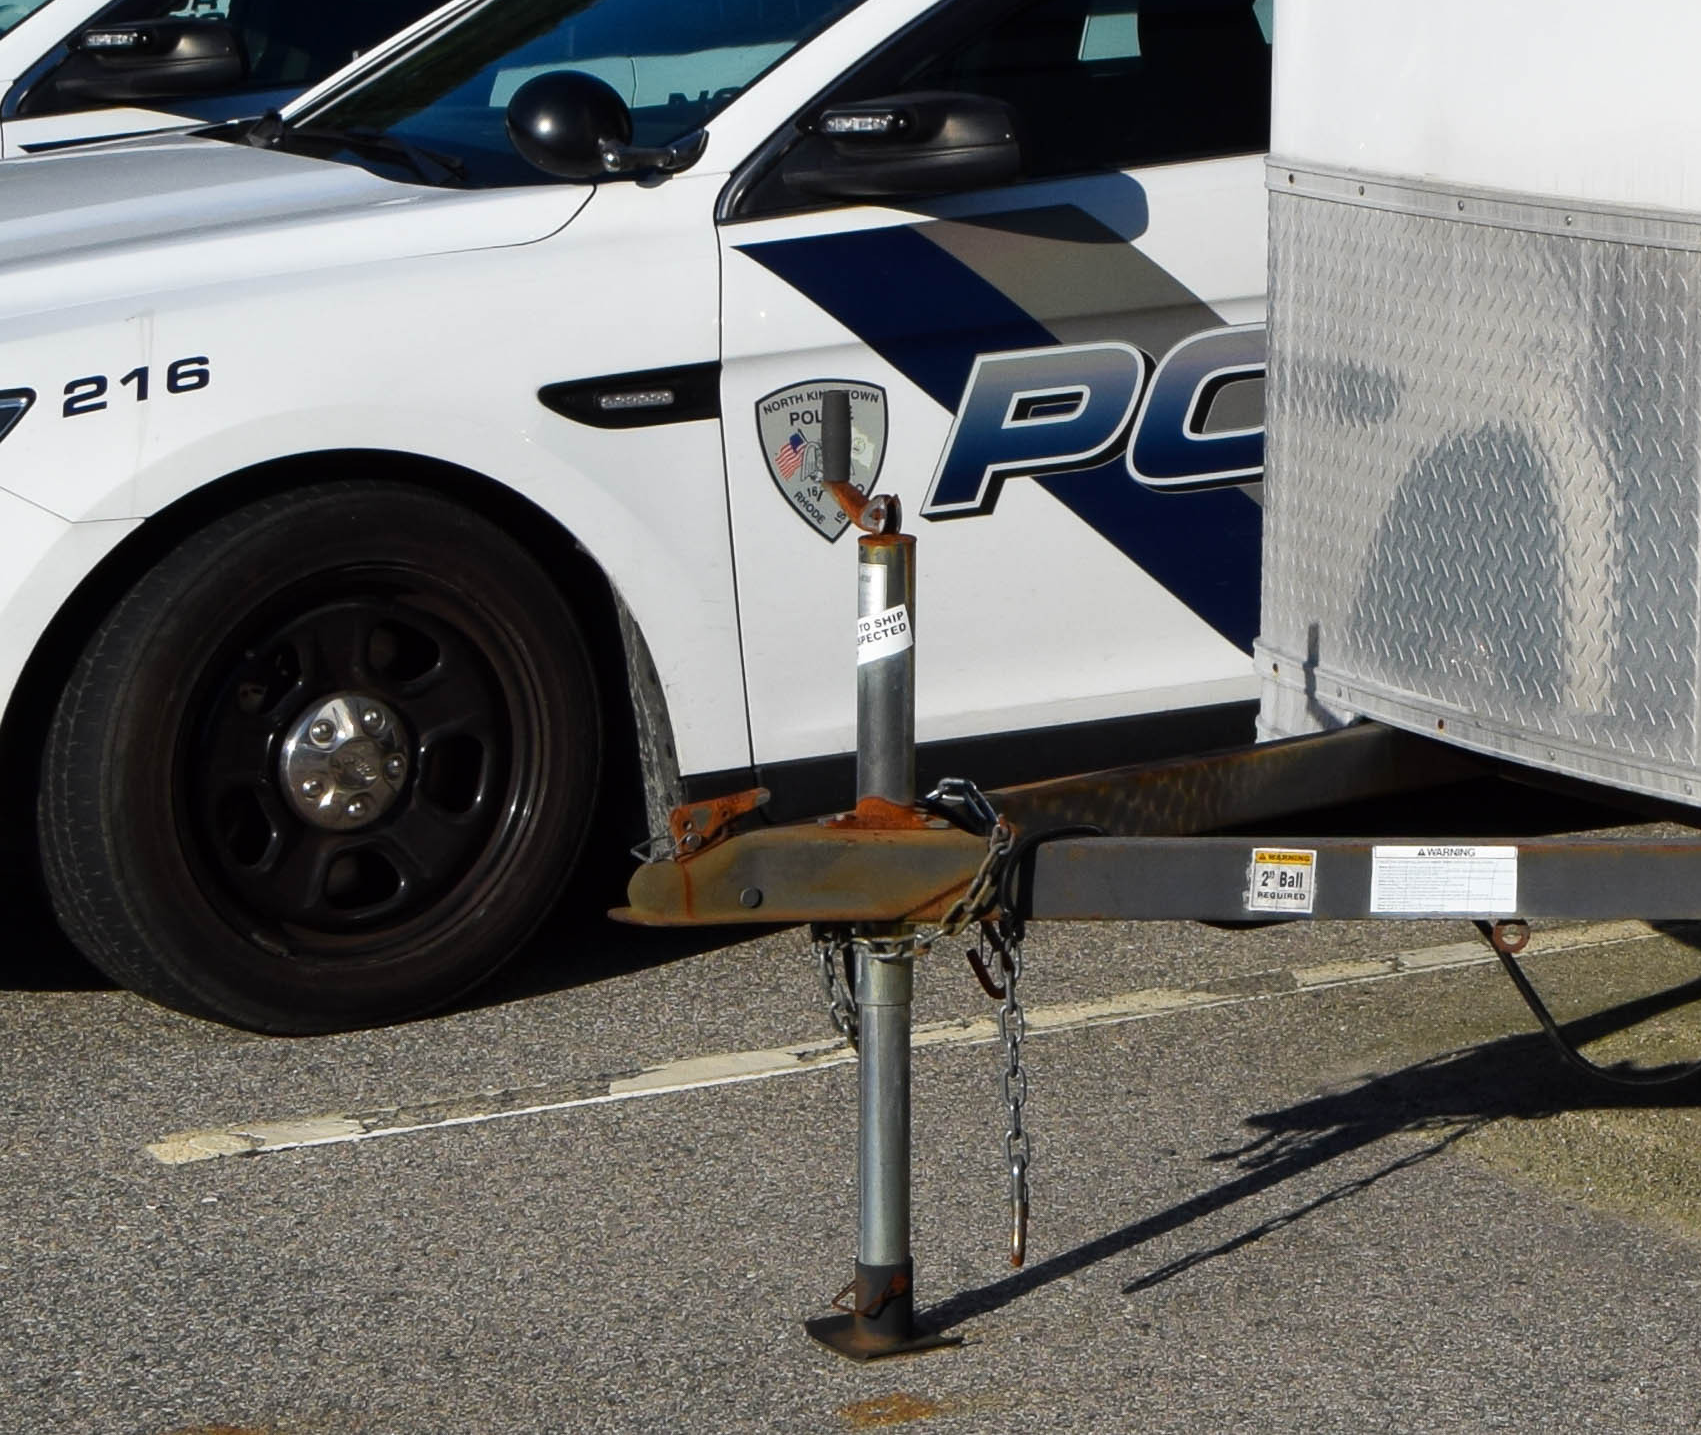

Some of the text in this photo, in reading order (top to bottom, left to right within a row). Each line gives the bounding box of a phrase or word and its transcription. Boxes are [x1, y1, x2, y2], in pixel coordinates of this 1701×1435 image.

[62, 356, 210, 418] 216
[763, 394, 803, 415] NORTH
[789, 405, 854, 426] POL
[794, 491, 826, 524] RHODE
[874, 611, 904, 628] SHIP
[857, 622, 906, 644] PECTED
[1268, 853, 1310, 862] WARNING
[1427, 848, 1475, 857] WARNING
[1279, 871, 1304, 888] Ball
[1257, 891, 1306, 901] REQUIRED
